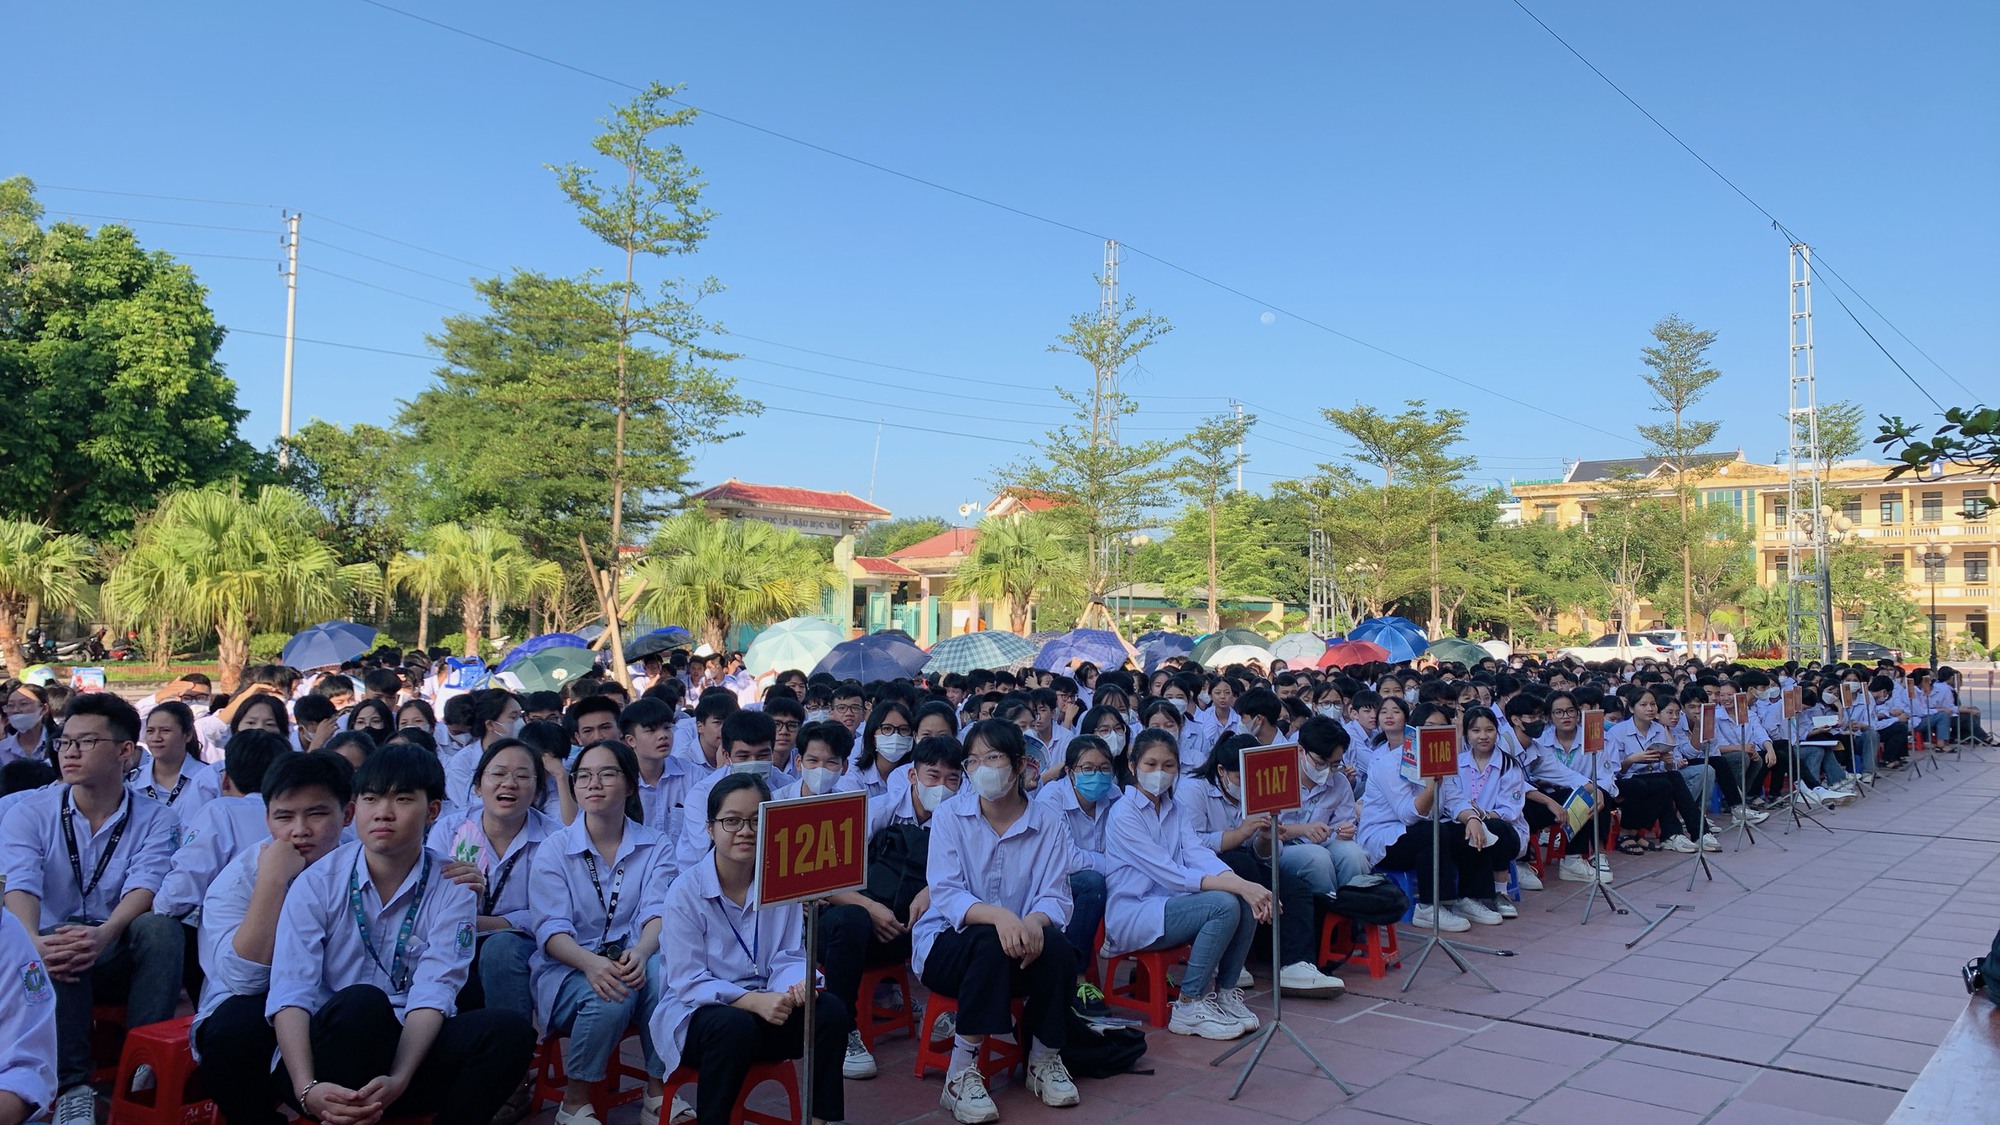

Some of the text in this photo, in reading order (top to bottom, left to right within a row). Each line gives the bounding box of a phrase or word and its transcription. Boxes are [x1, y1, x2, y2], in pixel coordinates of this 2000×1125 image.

[1428, 741, 1451, 763] 11A6
[1255, 765, 1288, 797] 11A7
[774, 817, 853, 878] 12A1
